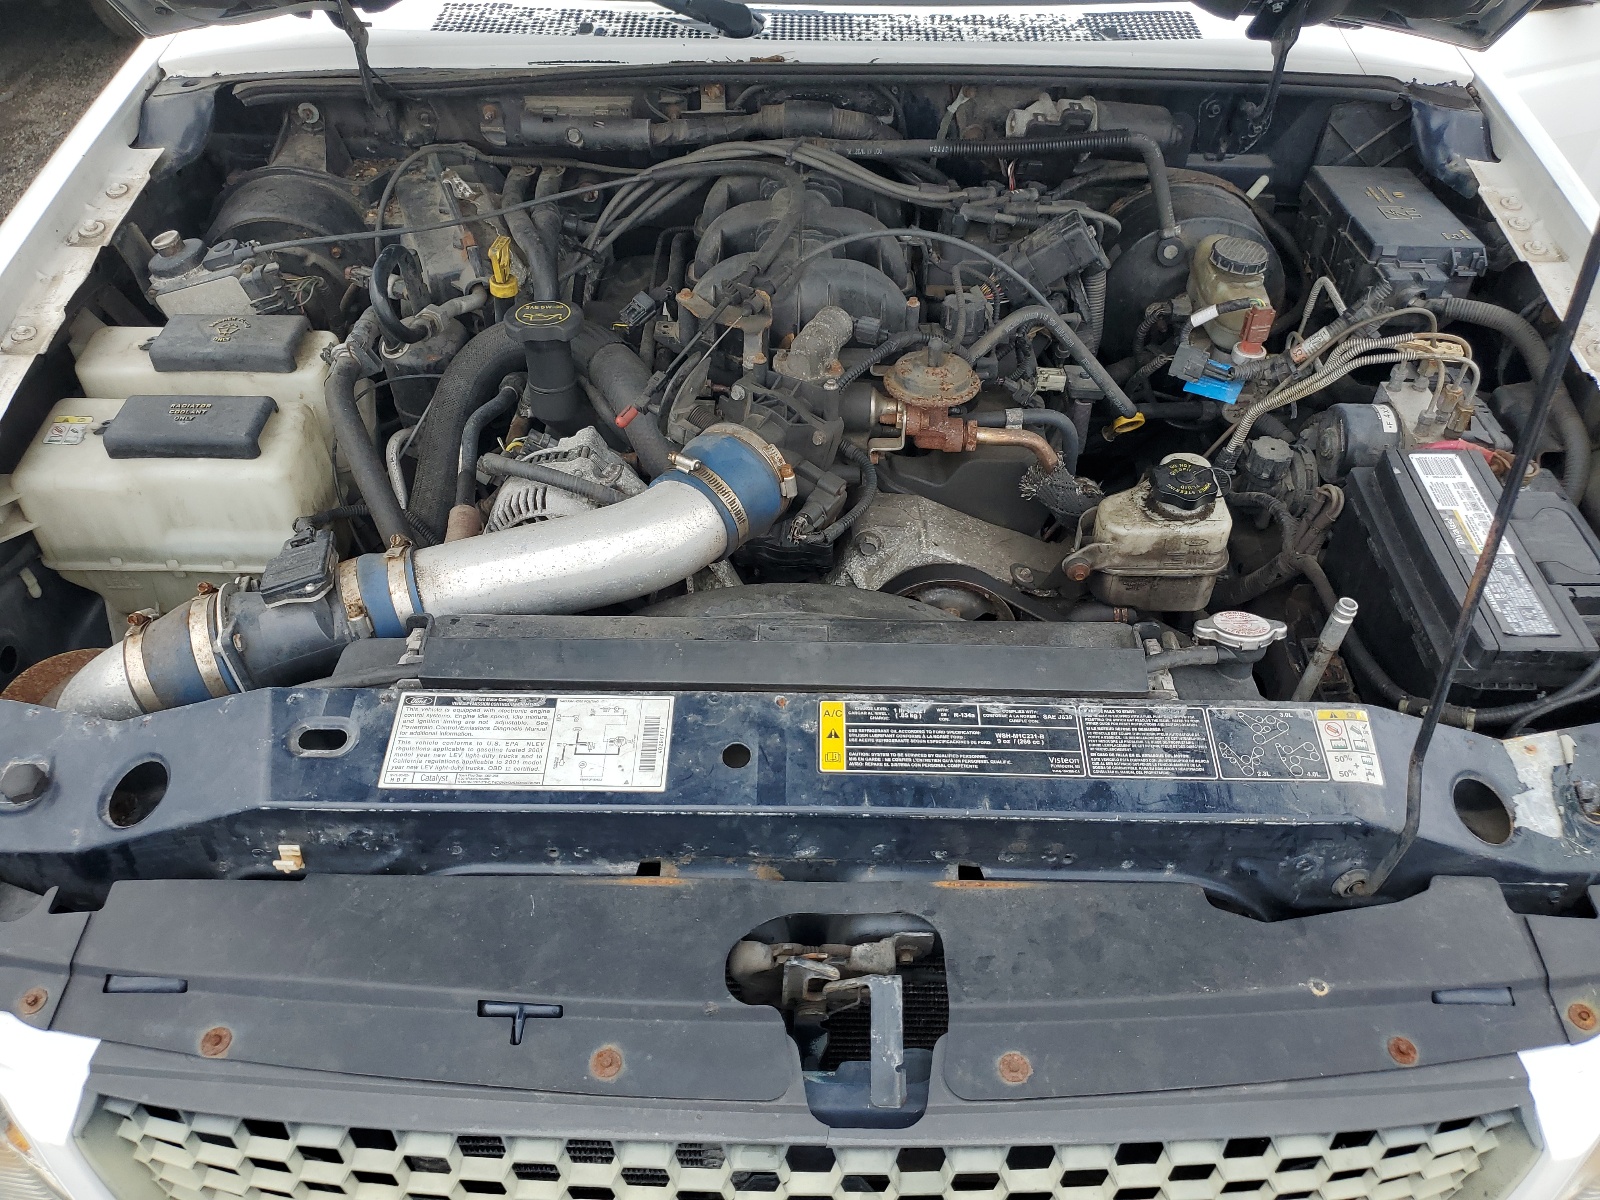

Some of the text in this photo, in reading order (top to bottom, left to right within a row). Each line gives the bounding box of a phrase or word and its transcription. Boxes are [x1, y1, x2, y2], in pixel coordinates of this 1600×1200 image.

[1166, 483, 1196, 495] STEERING
[824, 709, 842, 718] A/C
[420, 774, 448, 783] Catalyst
[1338, 770, 1356, 778] 50%
